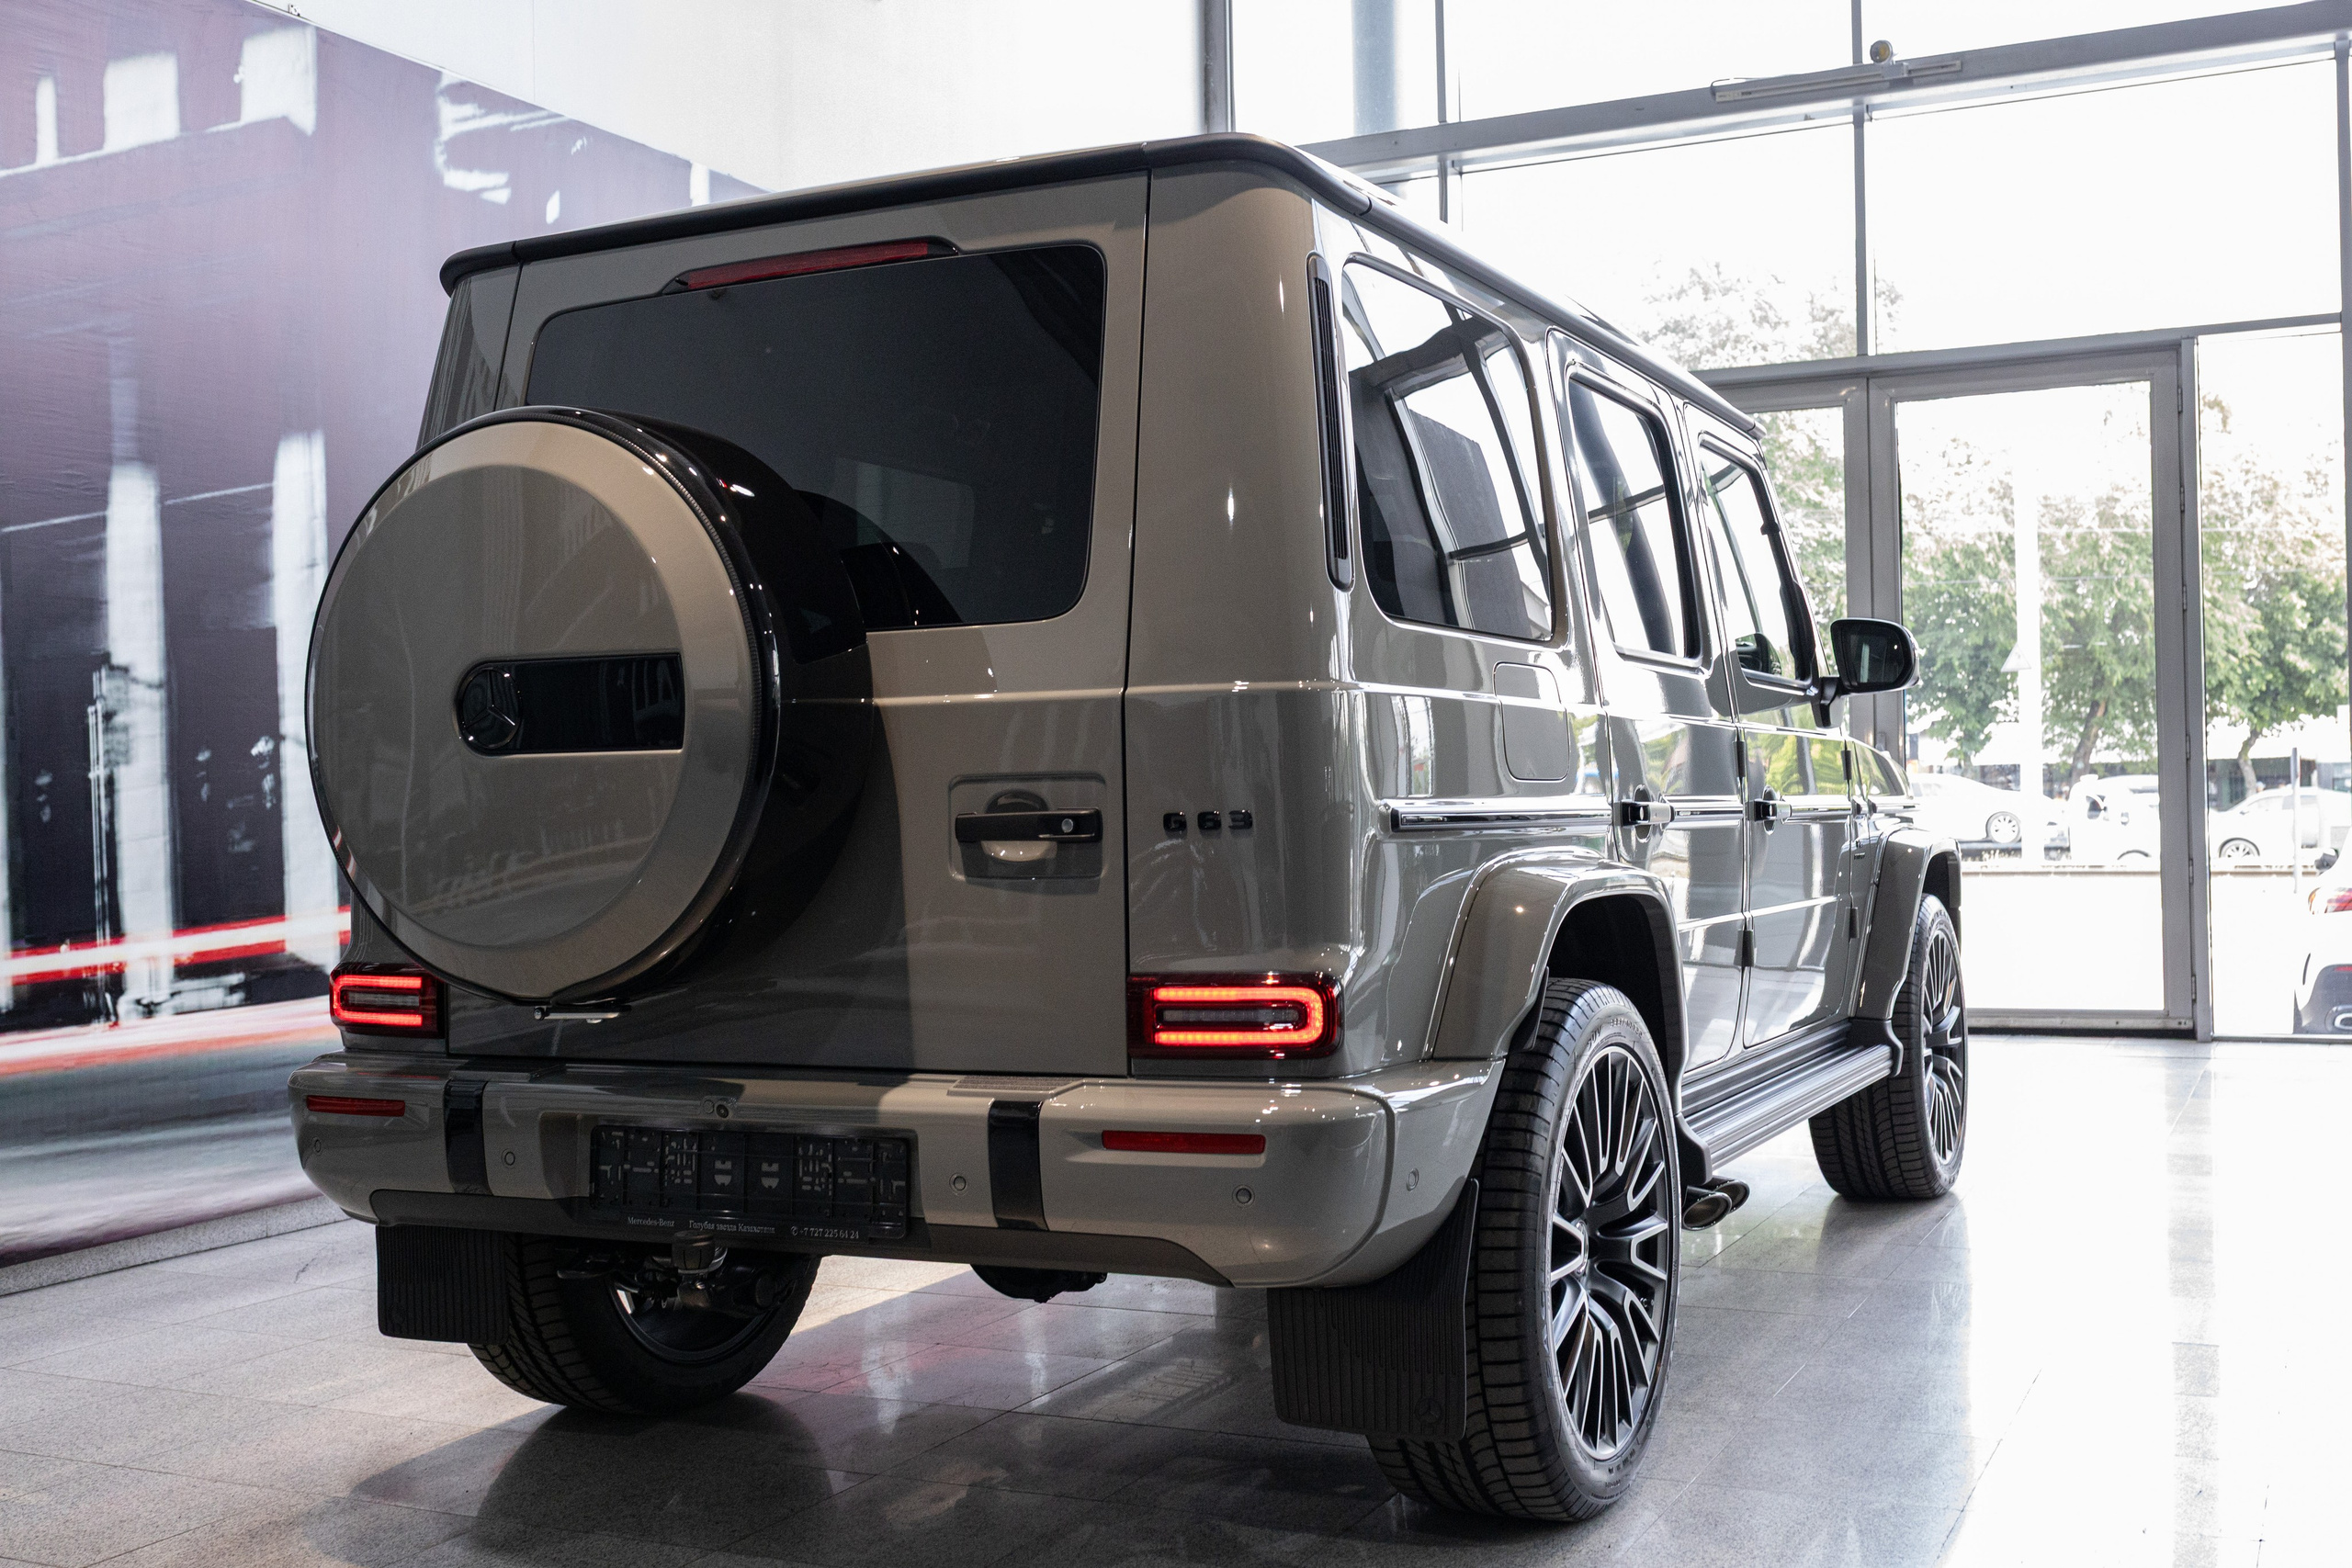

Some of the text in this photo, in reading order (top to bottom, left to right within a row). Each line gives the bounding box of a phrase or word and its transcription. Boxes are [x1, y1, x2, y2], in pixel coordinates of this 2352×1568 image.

[1163, 809, 1253, 831] G 63
[628, 1216, 675, 1227] Mercedes-Benz
[688, 1220, 715, 1231] Голубая
[799, 1227, 808, 1236] +7
[809, 1227, 823, 1237] 727
[824, 1228, 838, 1238] 225
[850, 1230, 860, 1240] 24
